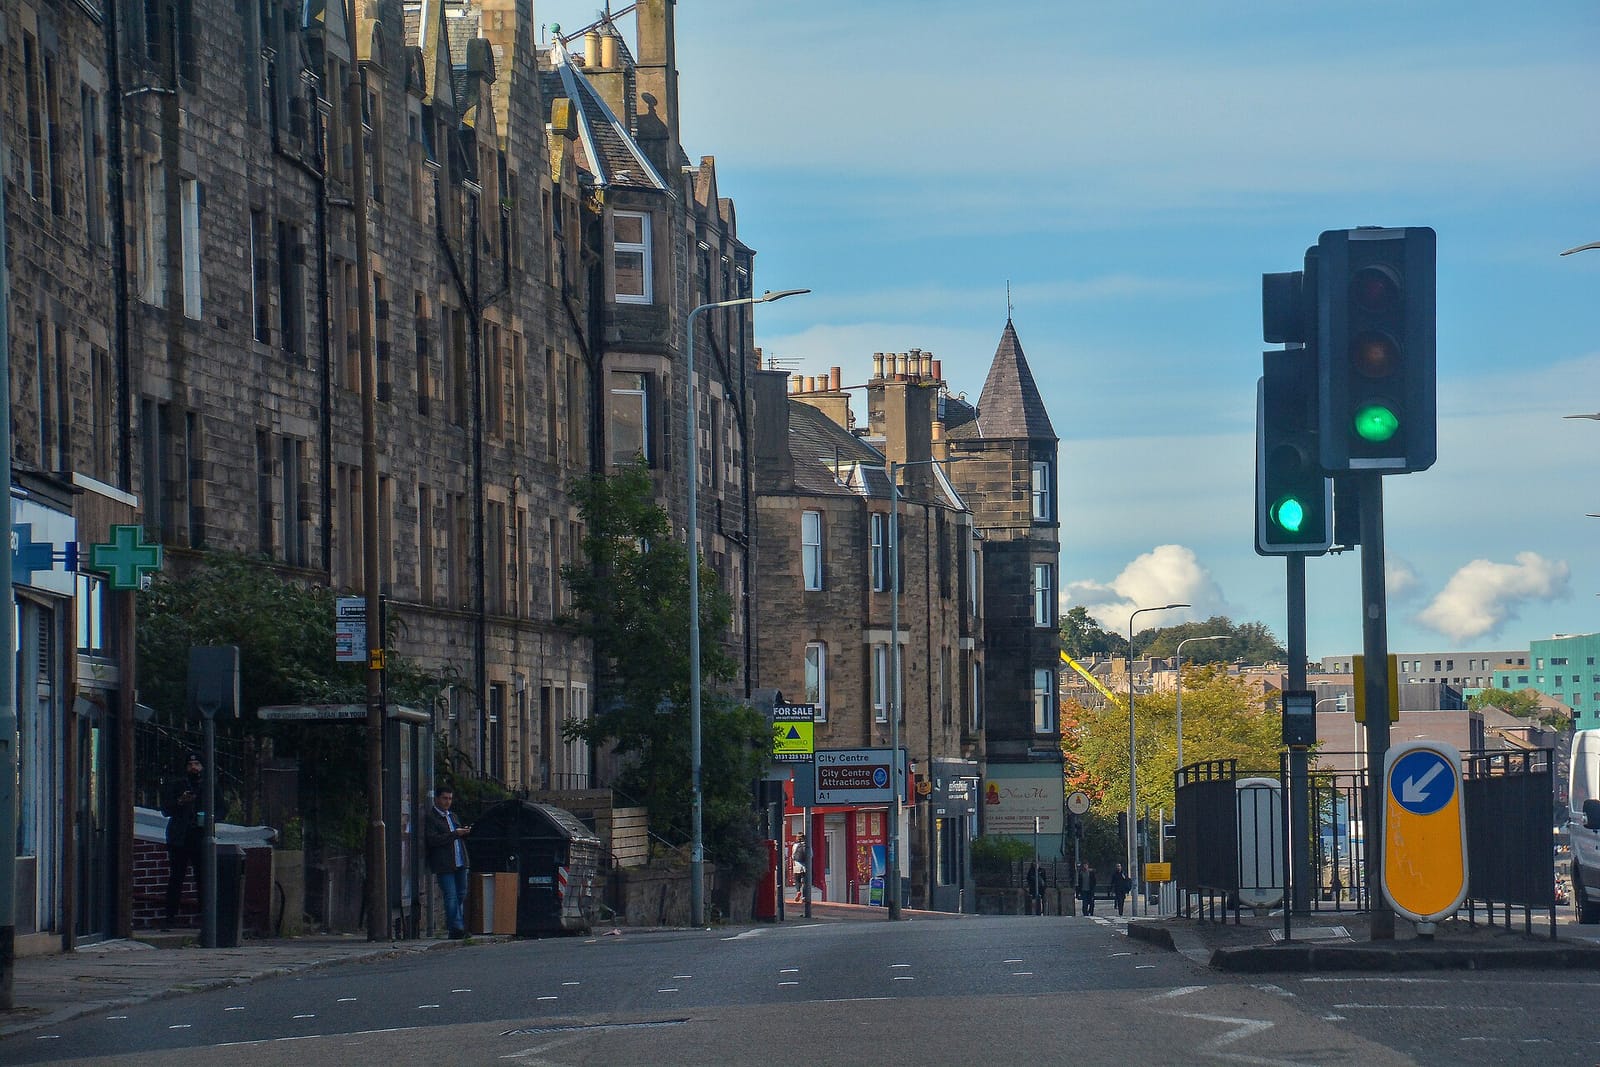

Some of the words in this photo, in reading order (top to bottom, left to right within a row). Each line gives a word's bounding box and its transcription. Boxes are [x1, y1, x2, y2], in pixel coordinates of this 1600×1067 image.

[773, 707, 790, 715] FOR
[792, 707, 813, 715] SALE
[818, 754, 836, 762] City
[839, 754, 869, 762] Centre
[821, 769, 839, 778] City
[841, 768, 871, 777] Centre
